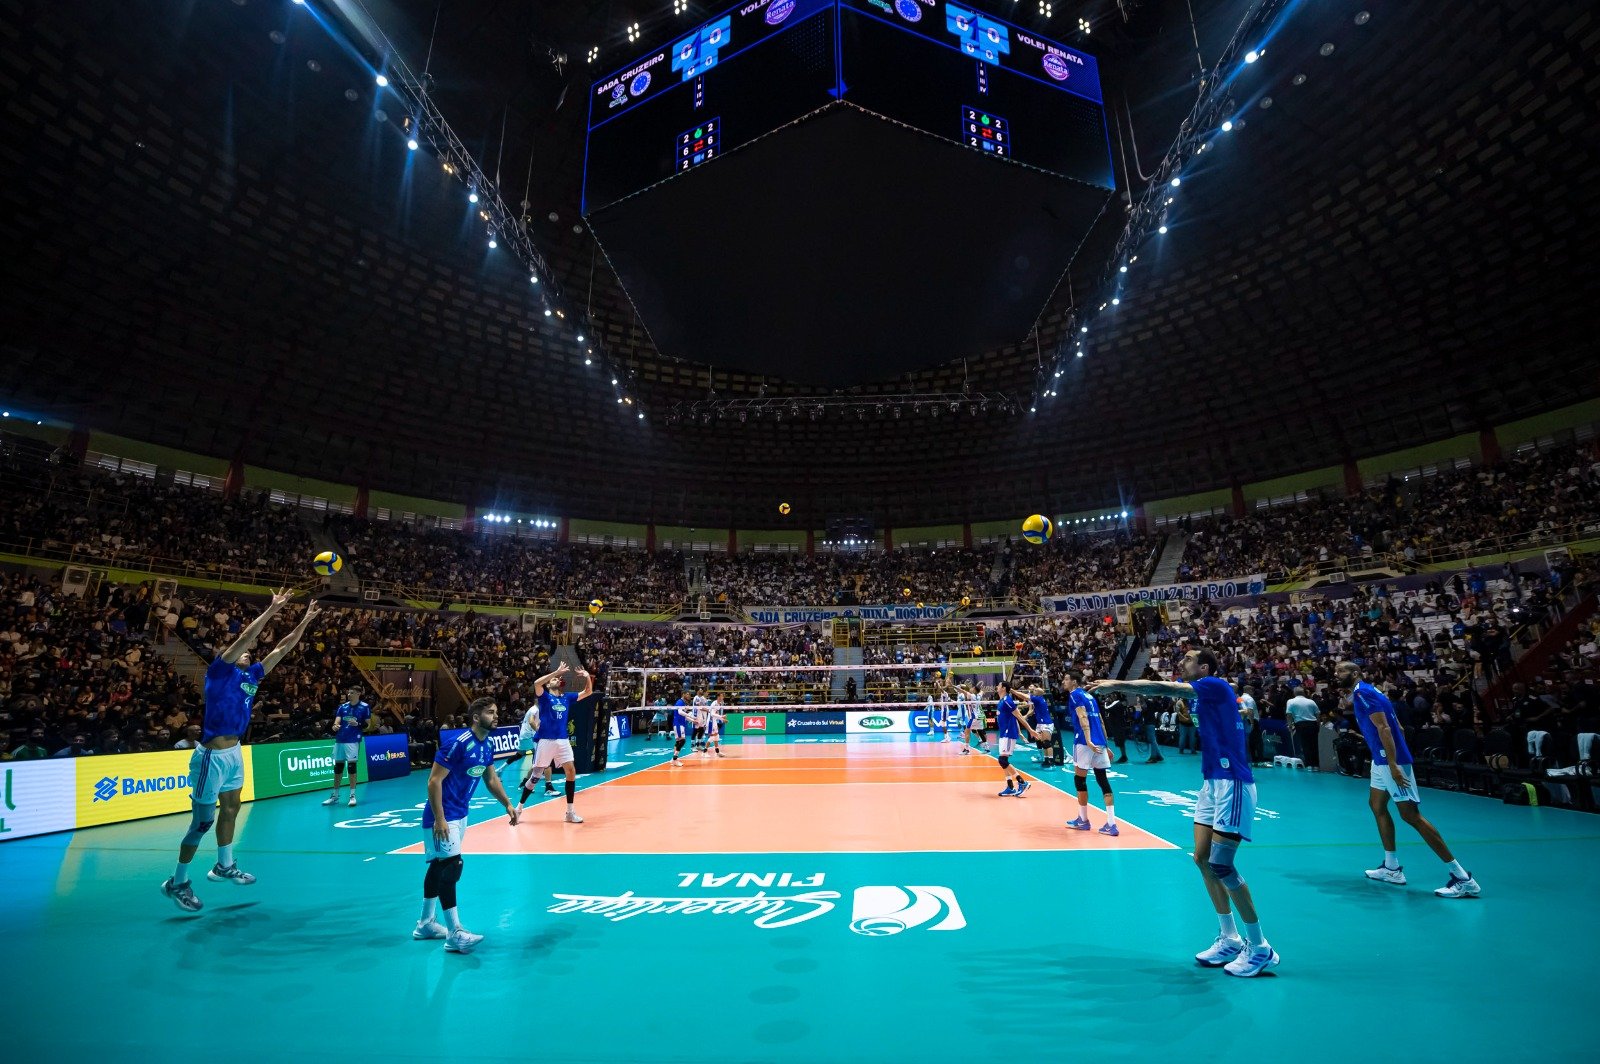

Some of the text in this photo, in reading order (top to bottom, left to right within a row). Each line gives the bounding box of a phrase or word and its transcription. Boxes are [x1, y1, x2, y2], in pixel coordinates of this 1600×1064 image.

[956, 15, 1000, 44] 0 0
[680, 43, 693, 60] 0
[709, 28, 722, 45] 0
[1016, 33, 1084, 66] VOLEI RENATA
[597, 78, 620, 95] SADA
[621, 53, 665, 82] CRUZEIRO
[969, 110, 1002, 128] 2 2
[683, 122, 714, 144] 2 2
[970, 124, 1003, 141] 6 6
[683, 136, 713, 156] 6 6
[971, 137, 1004, 155] 2 2
[683, 149, 713, 169] 2 2
[1066, 582, 1238, 613] SADA CRUZEIRO
[750, 612, 780, 623] SADA
[894, 607, 945, 619] HOSPICIO
[861, 718, 891, 726] SADA
[287, 755, 336, 771] Unime
[122, 777, 176, 795] BANCO
[678, 872, 826, 888] FINAL
